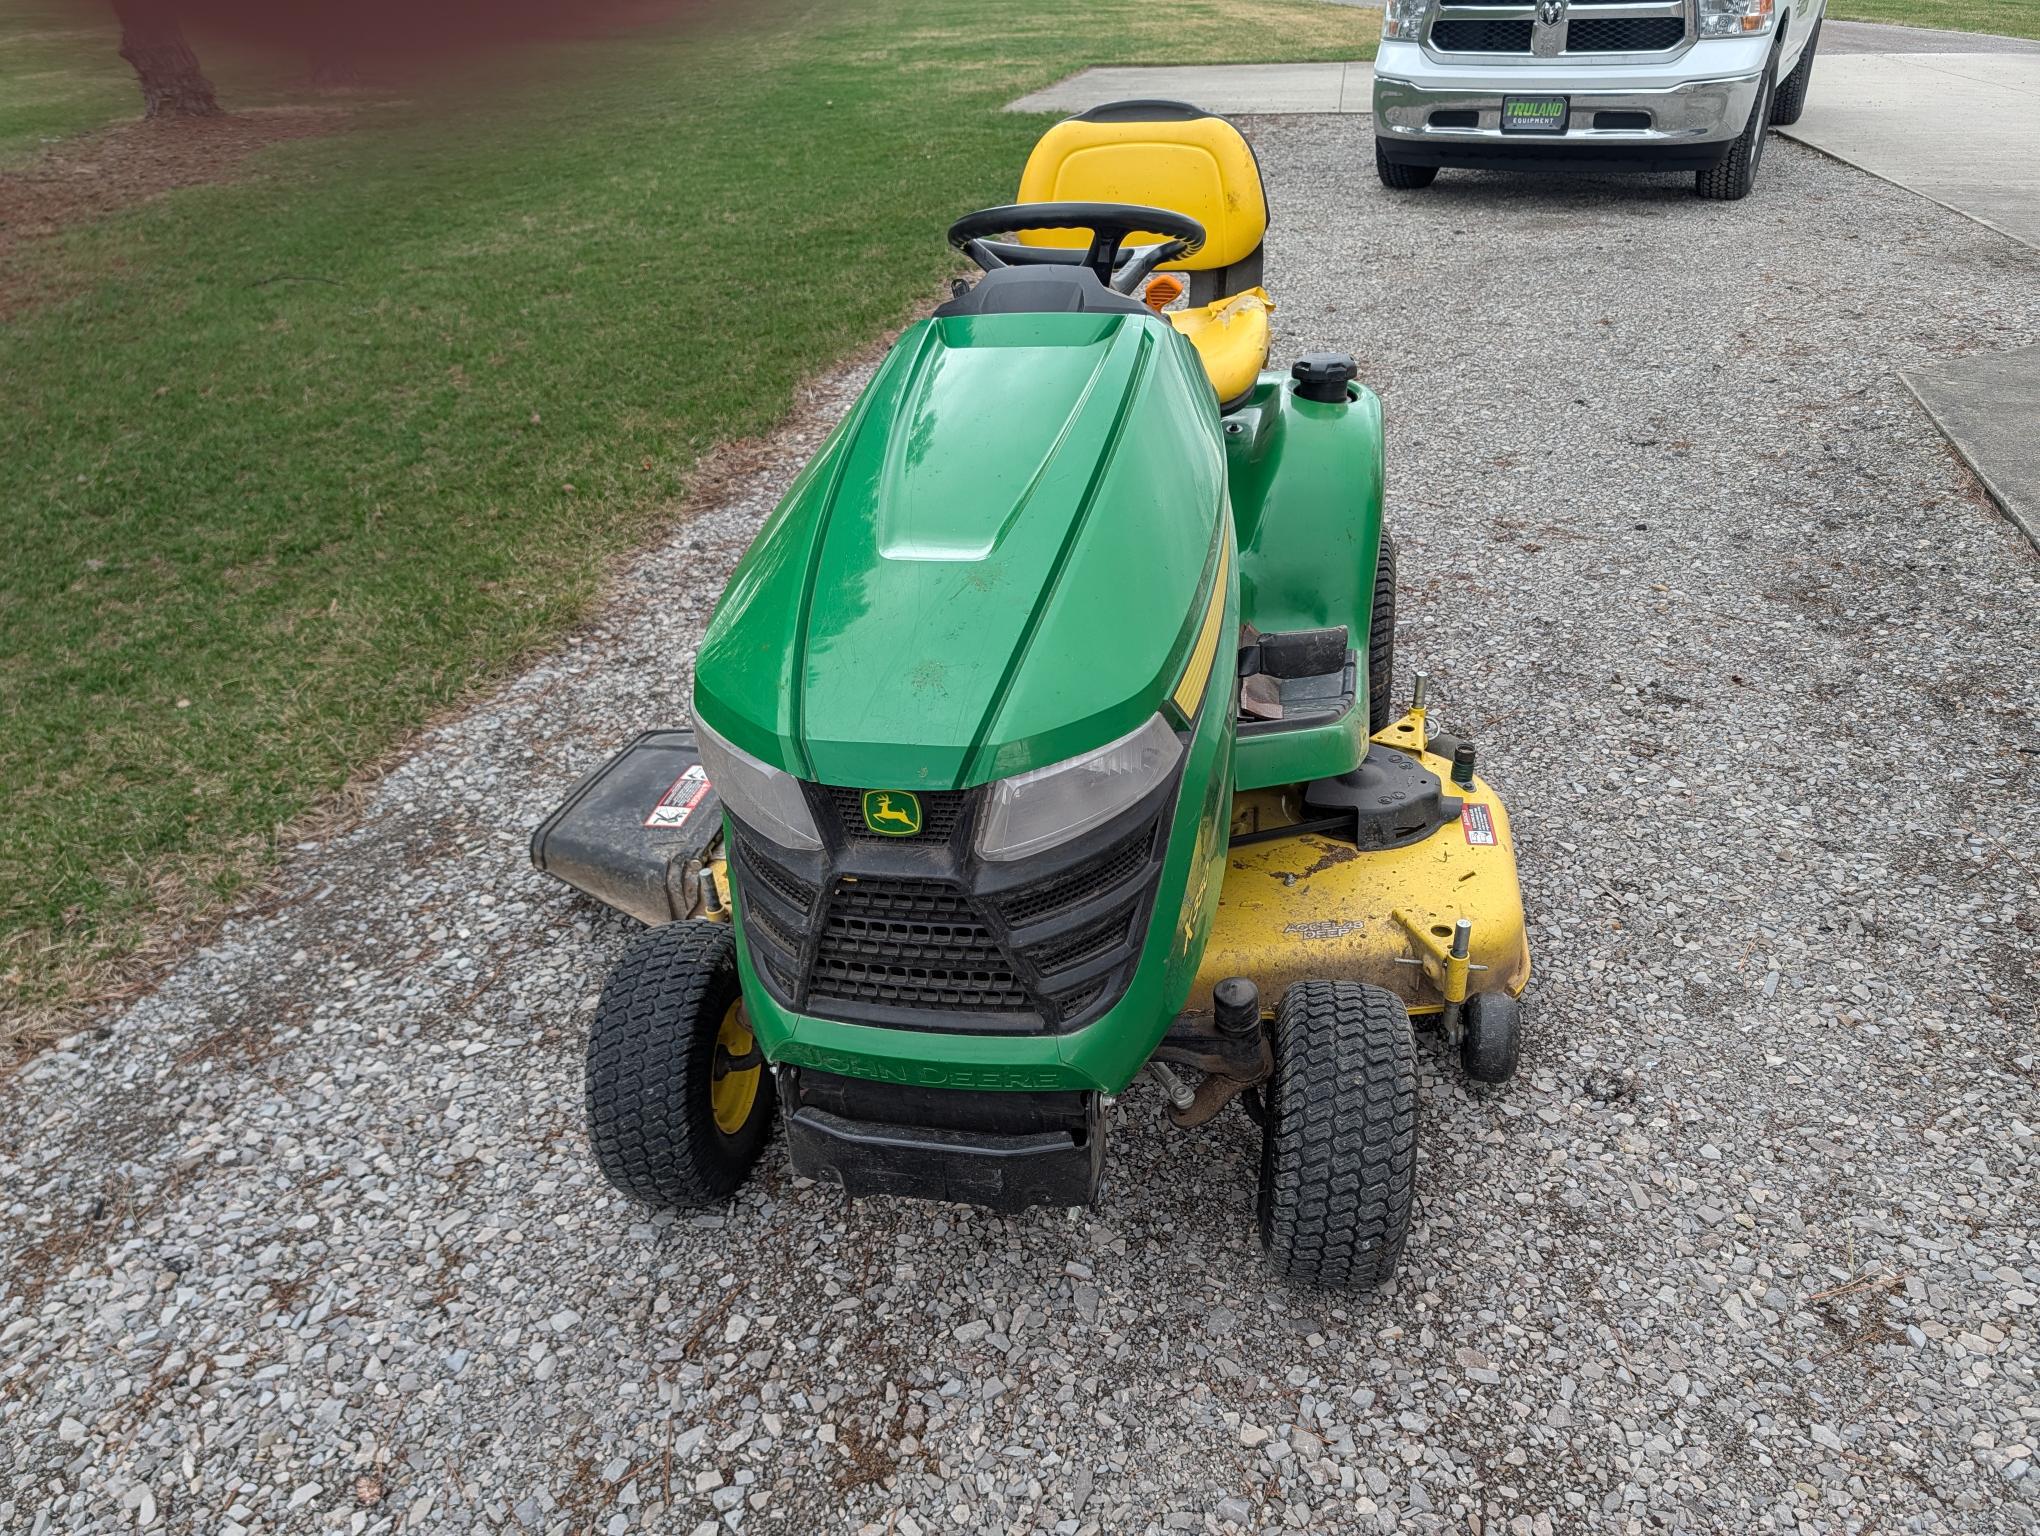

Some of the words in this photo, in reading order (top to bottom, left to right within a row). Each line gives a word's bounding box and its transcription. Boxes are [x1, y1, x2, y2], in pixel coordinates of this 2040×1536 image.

[1507, 103, 1563, 116] TRULAND
[1283, 922, 1341, 932] ACCEL
[1303, 928, 1350, 939] DEEP
[802, 1049, 907, 1082] JOHN
[919, 1068, 1059, 1088] DEERE
